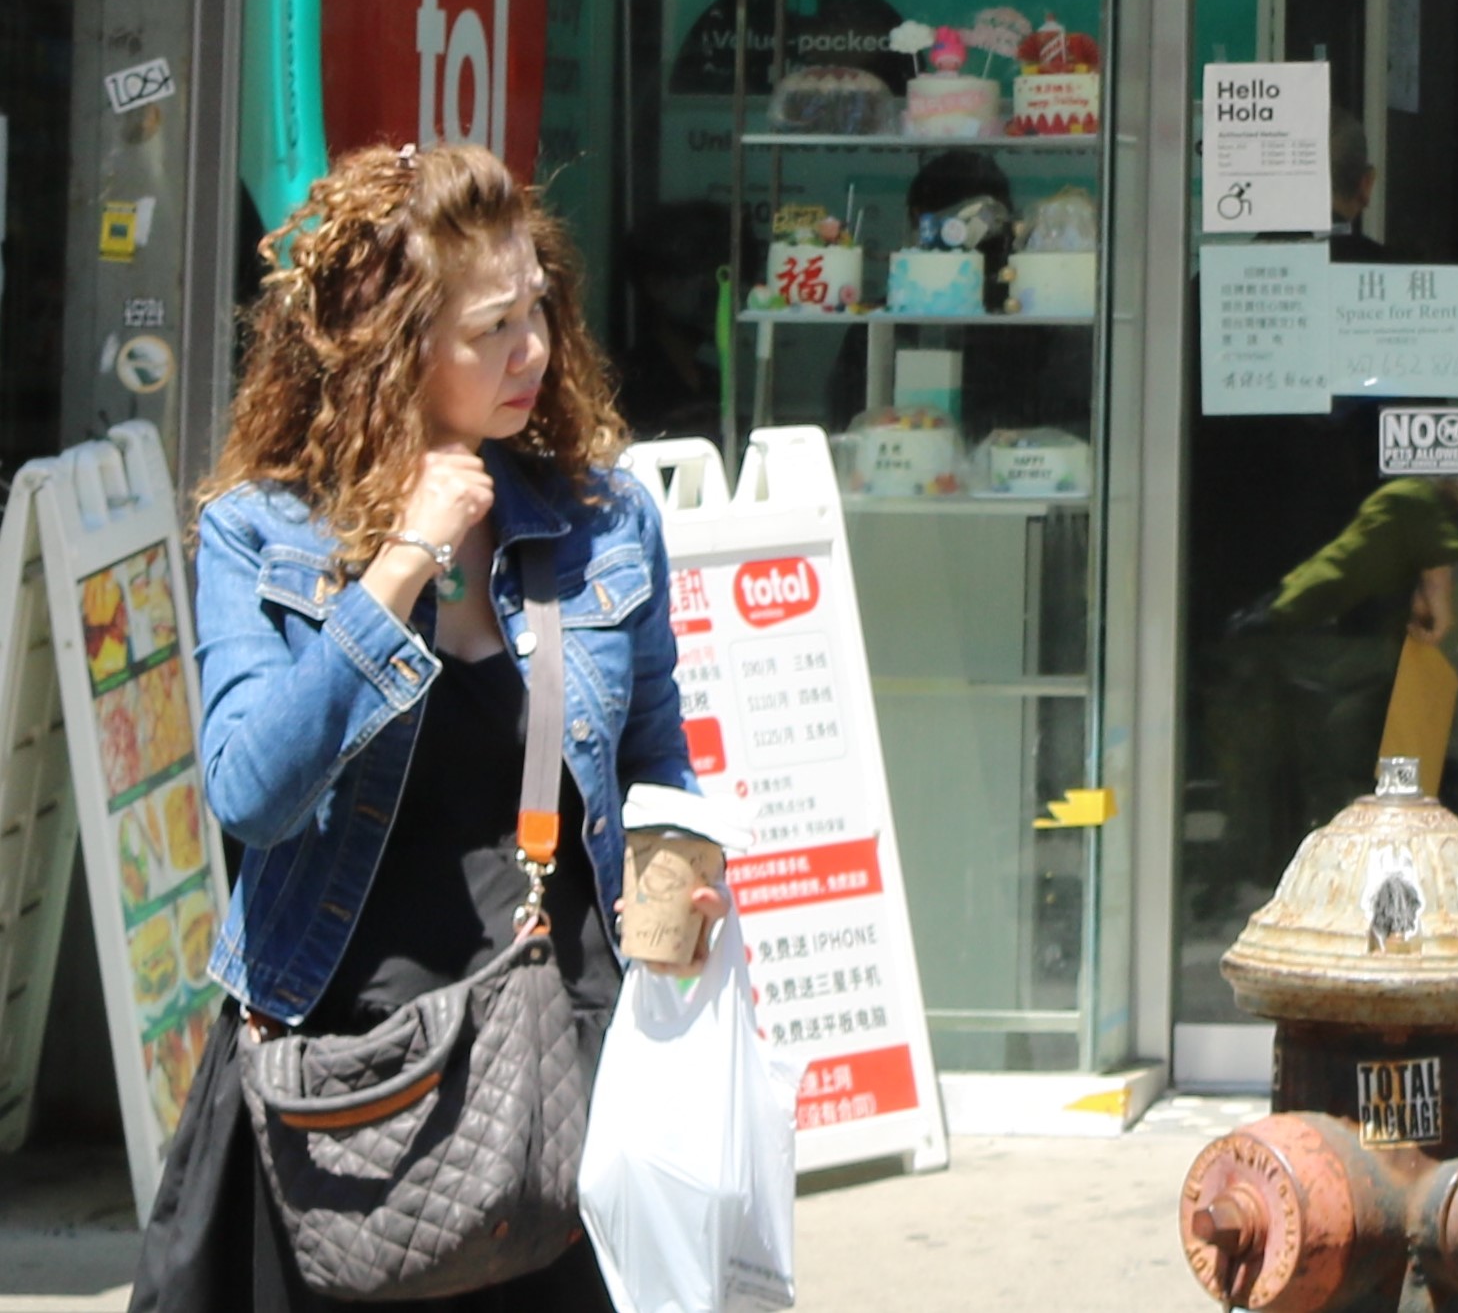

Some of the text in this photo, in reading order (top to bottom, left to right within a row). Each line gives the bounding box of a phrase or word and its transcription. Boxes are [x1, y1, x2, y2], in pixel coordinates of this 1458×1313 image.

[1216, 80, 1281, 100] Hello
[1216, 103, 1275, 122] Hola
[777, 254, 828, 306] 福
[1336, 303, 1458, 324] Space for Rent
[1386, 415, 1434, 448] NO
[741, 561, 811, 607] total
[812, 923, 878, 953] IPHONE
[1360, 1061, 1439, 1101] TOTAL
[1361, 1099, 1440, 1139] PACKAGE
